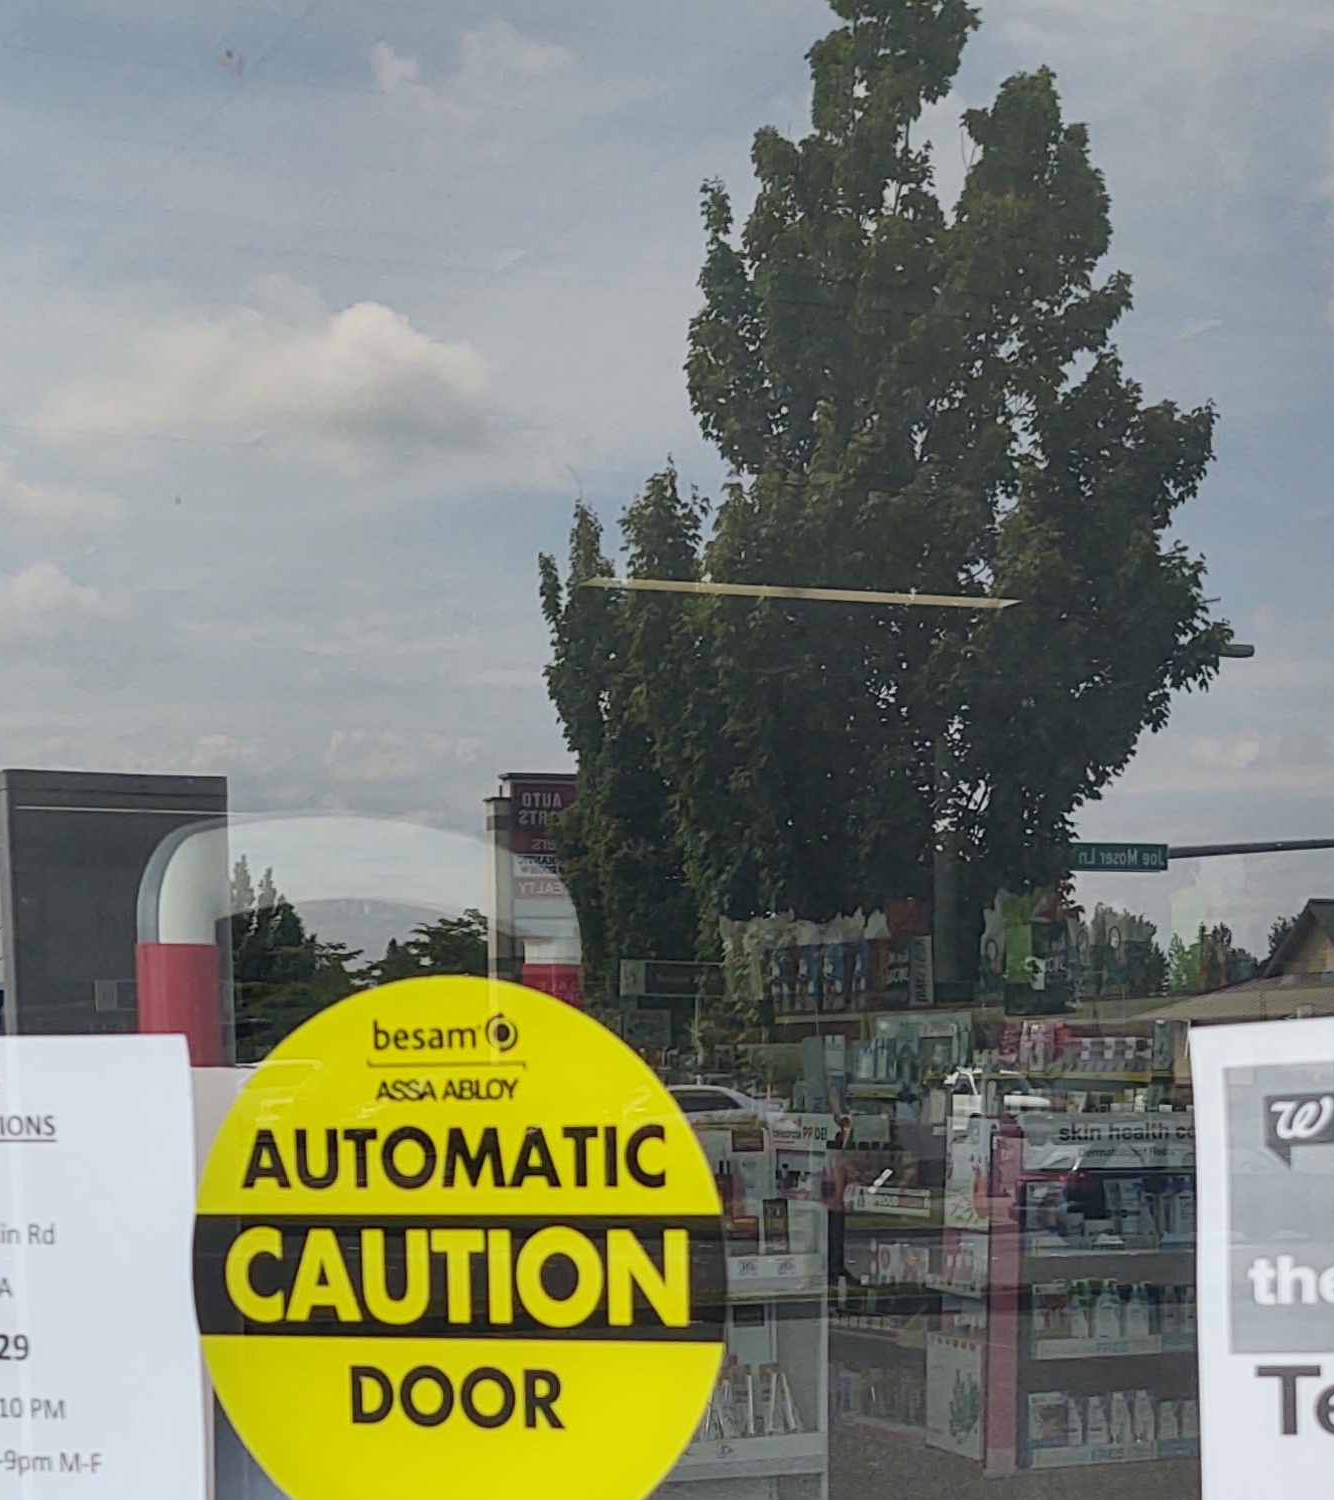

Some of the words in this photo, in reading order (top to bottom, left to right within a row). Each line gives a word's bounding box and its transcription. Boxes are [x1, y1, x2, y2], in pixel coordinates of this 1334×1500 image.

[373, 1020, 477, 1051] besam
[375, 1080, 435, 1101] ASSA
[443, 1079, 519, 1101] ABLOY
[803, 1127, 827, 1140] PRDE!
[1059, 1123, 1101, 1141] skin
[1109, 1123, 1168, 1140] health
[241, 1124, 667, 1190] AUTOMATIC
[27, 1224, 55, 1245] Rd
[225, 1225, 690, 1329] CAUTION
[350, 1364, 565, 1429] DOOR
[30, 1399, 66, 1419] PM
[59, 1453, 102, 1474] M-F
